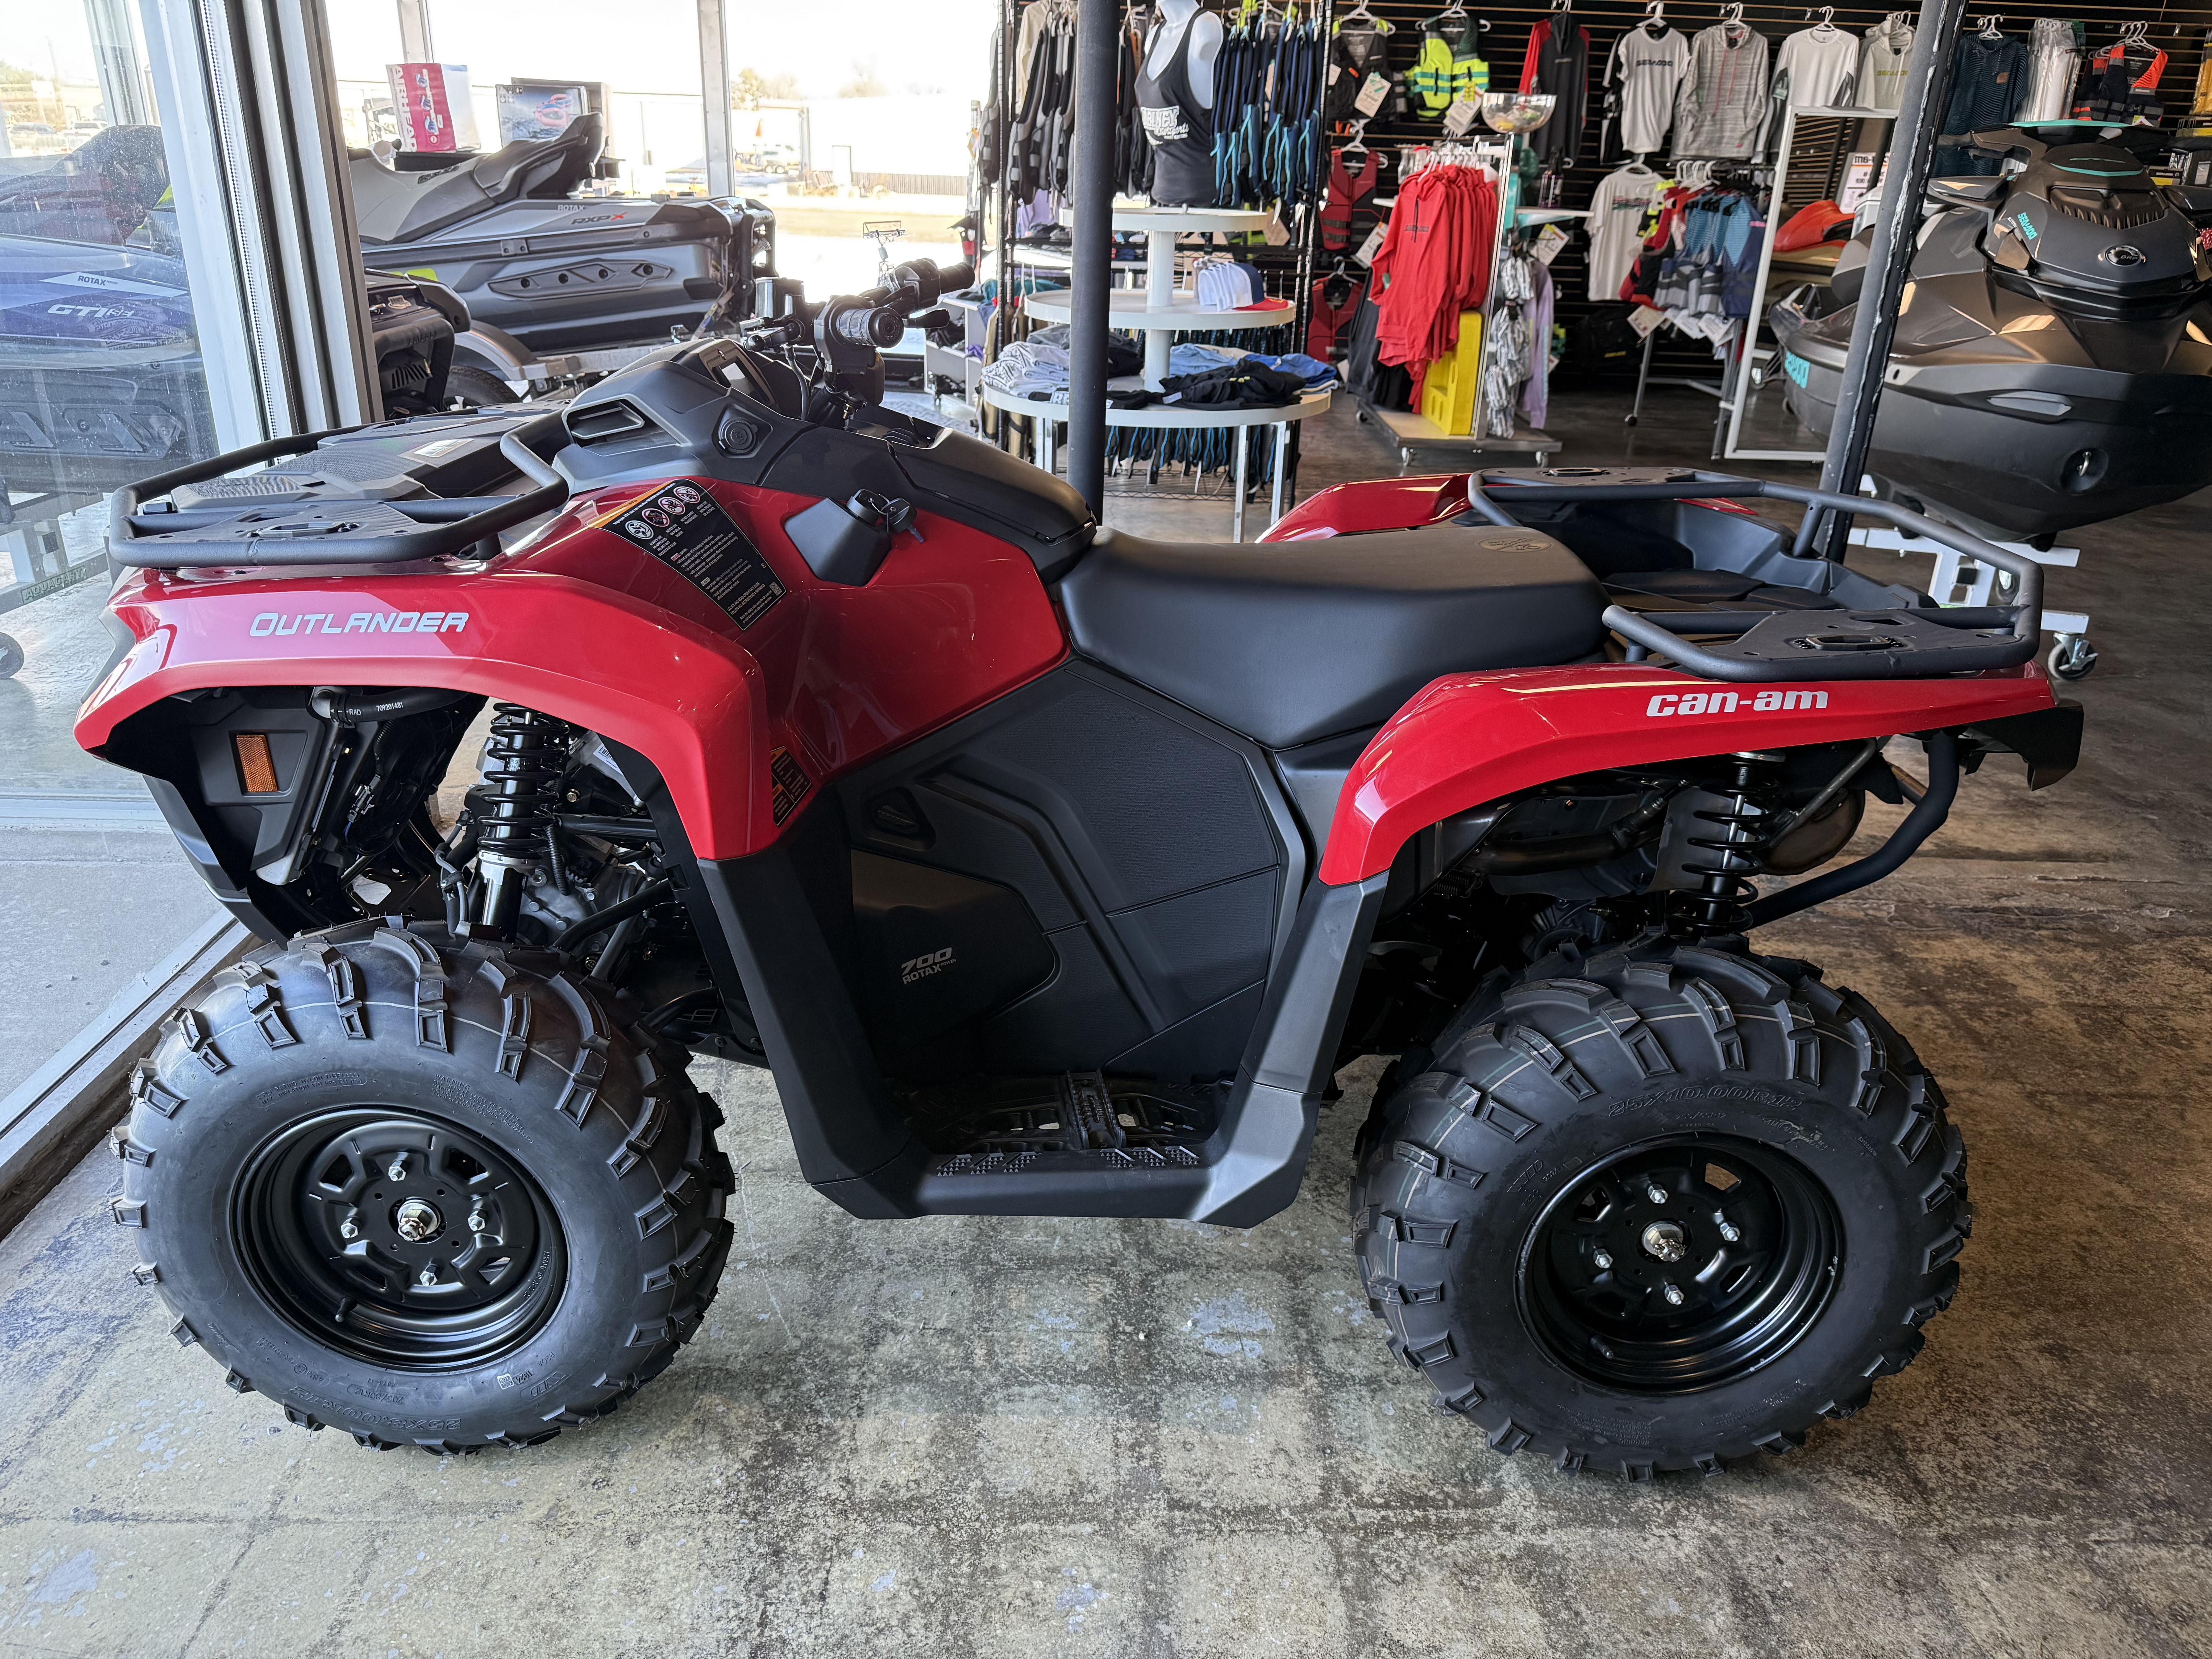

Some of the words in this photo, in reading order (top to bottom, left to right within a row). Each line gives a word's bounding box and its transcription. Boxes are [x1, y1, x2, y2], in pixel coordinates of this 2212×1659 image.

[394, 65, 417, 152] AIRHEAD
[78, 275, 106, 286] ROTAX
[25, 568, 83, 601] AQUACART
[250, 612, 469, 636] OUTLANDER
[376, 702, 403, 711] 709201481
[1646, 691, 1828, 717] can-am
[901, 947, 952, 976] 700
[902, 963, 942, 984] ROTAX
[940, 958, 956, 967] POWER
[275, 1081, 297, 1090] RATING
[301, 1075, 323, 1084] NYLON
[290, 1386, 461, 1430] 25X8.00R12
[354, 1388, 404, 1405] 205/80R12
